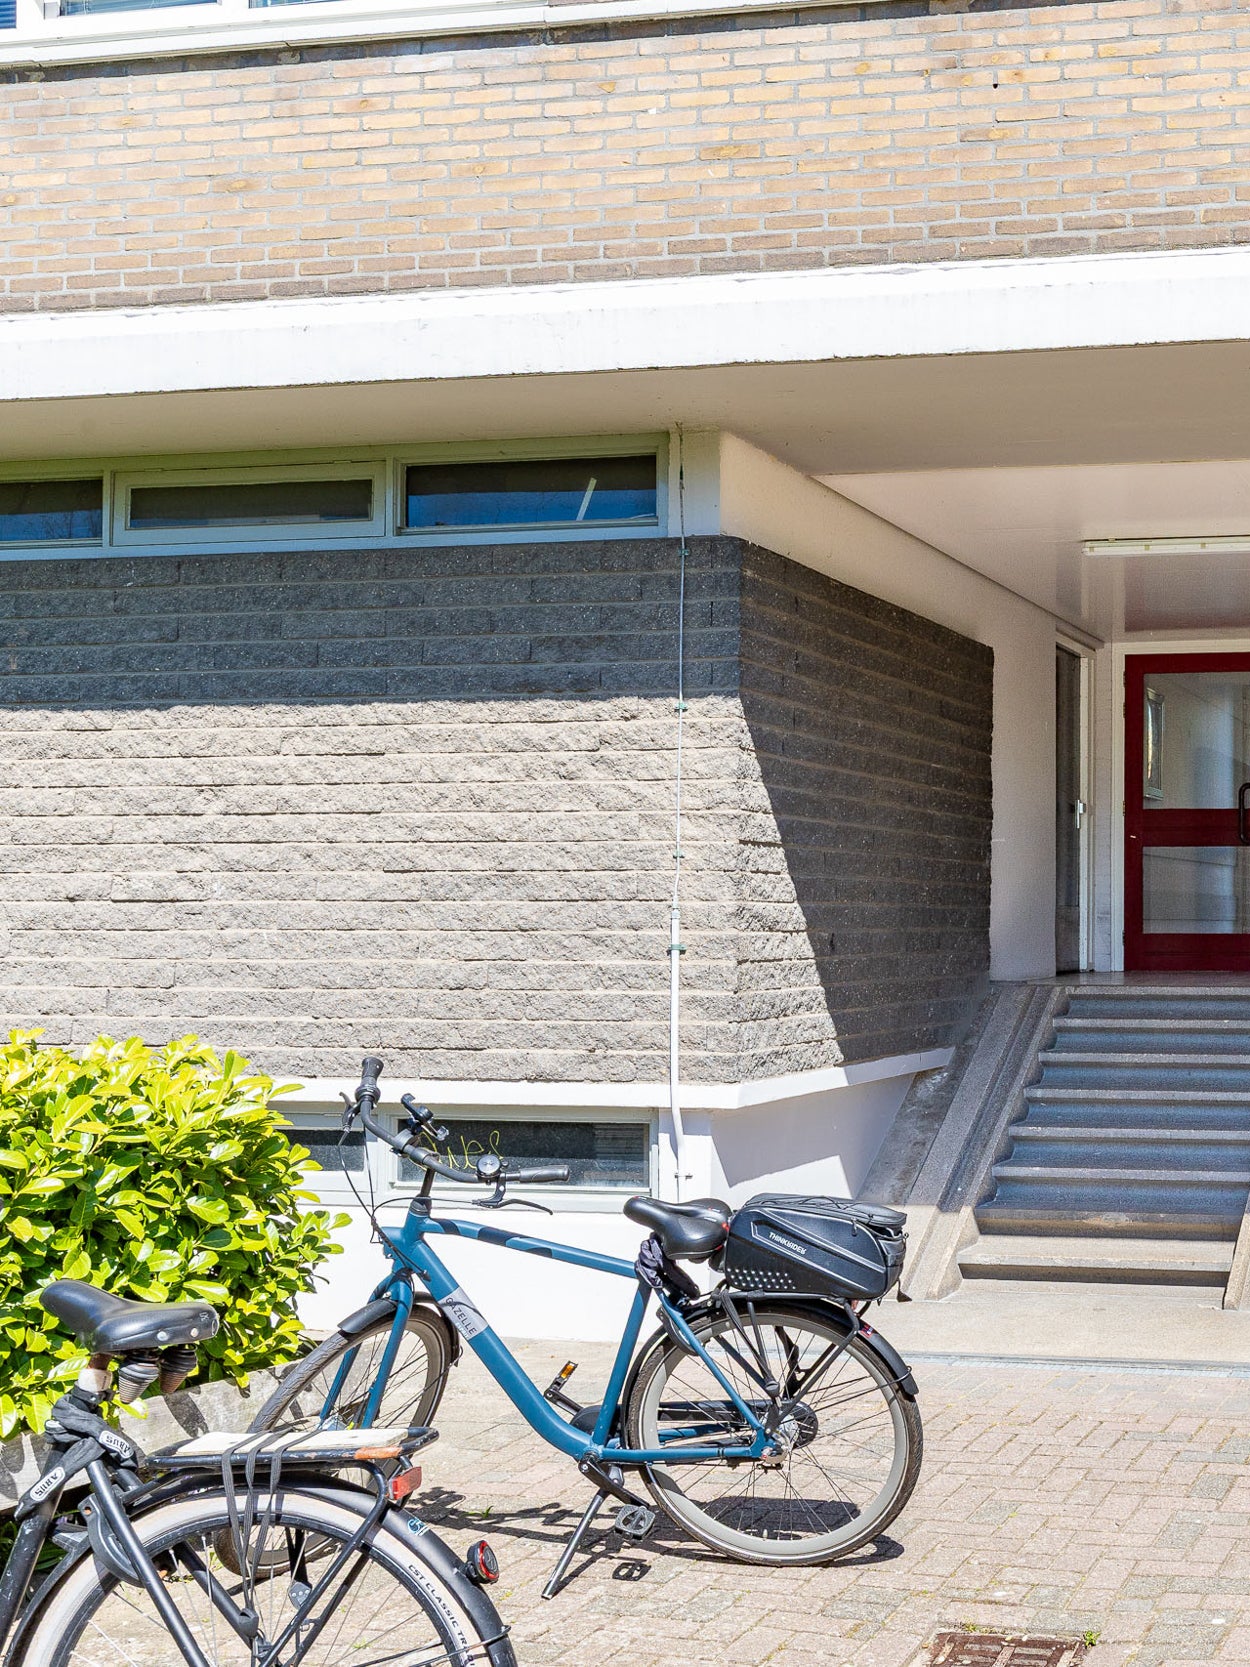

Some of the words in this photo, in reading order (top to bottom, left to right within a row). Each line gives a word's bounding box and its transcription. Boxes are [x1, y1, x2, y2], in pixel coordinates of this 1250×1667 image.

[446, 1297, 477, 1335] GAZELLE
[106, 1435, 131, 1453] ABUS
[35, 1473, 58, 1496] ABUS
[408, 1564, 426, 1580] CST
[425, 1582, 459, 1628] CLASSIC
